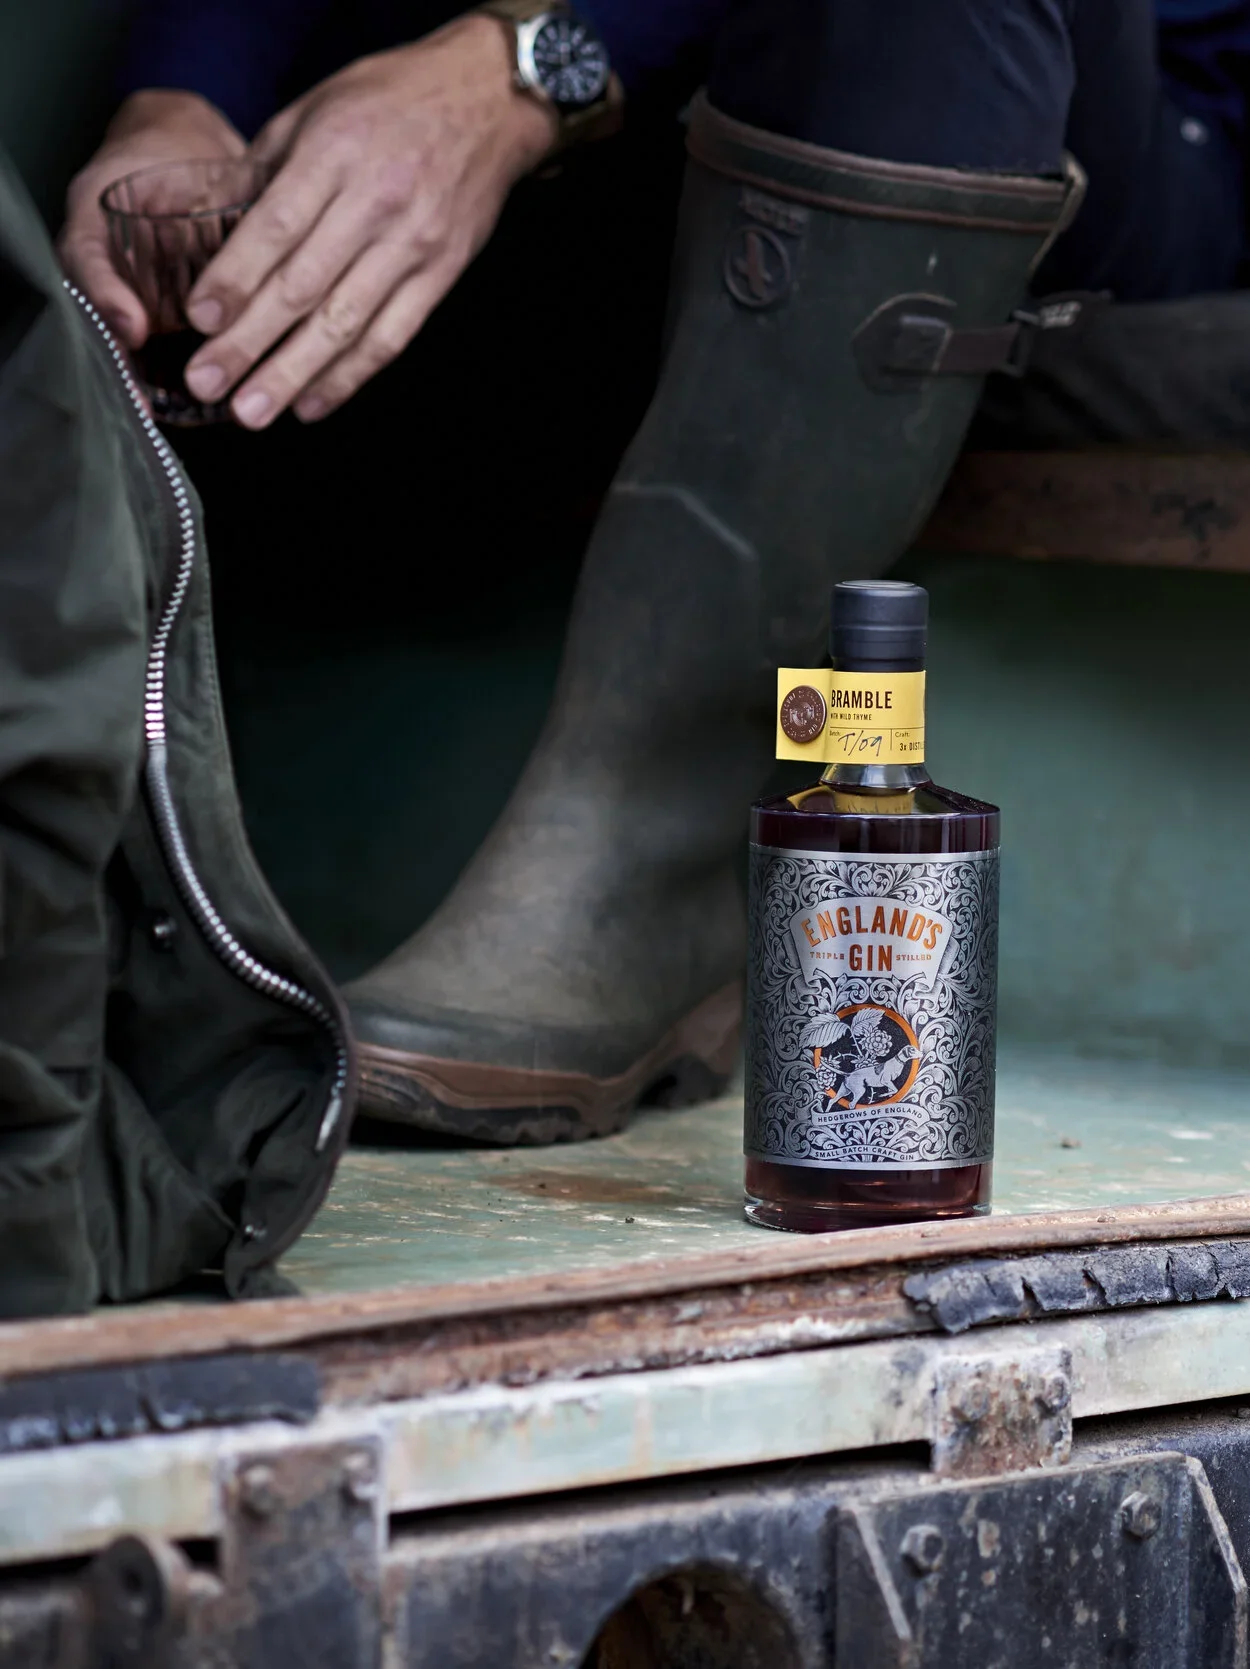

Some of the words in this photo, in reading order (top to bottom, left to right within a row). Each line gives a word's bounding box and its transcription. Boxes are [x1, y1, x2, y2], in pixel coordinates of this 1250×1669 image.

[831, 689, 893, 709] BRAMBLE
[899, 743, 907, 751] 3x
[800, 906, 943, 950] ENGLAND'S
[809, 951, 845, 960] TRIPLE
[895, 954, 932, 962] STILLED
[848, 944, 892, 972] GIN
[817, 1110, 867, 1123] HEDGEROWS
[870, 1108, 881, 1116] OF
[885, 1108, 923, 1120] ENGLAND
[815, 1150, 840, 1158] SMALL
[842, 1146, 869, 1154] BATCH
[871, 1147, 898, 1157] CRAFT
